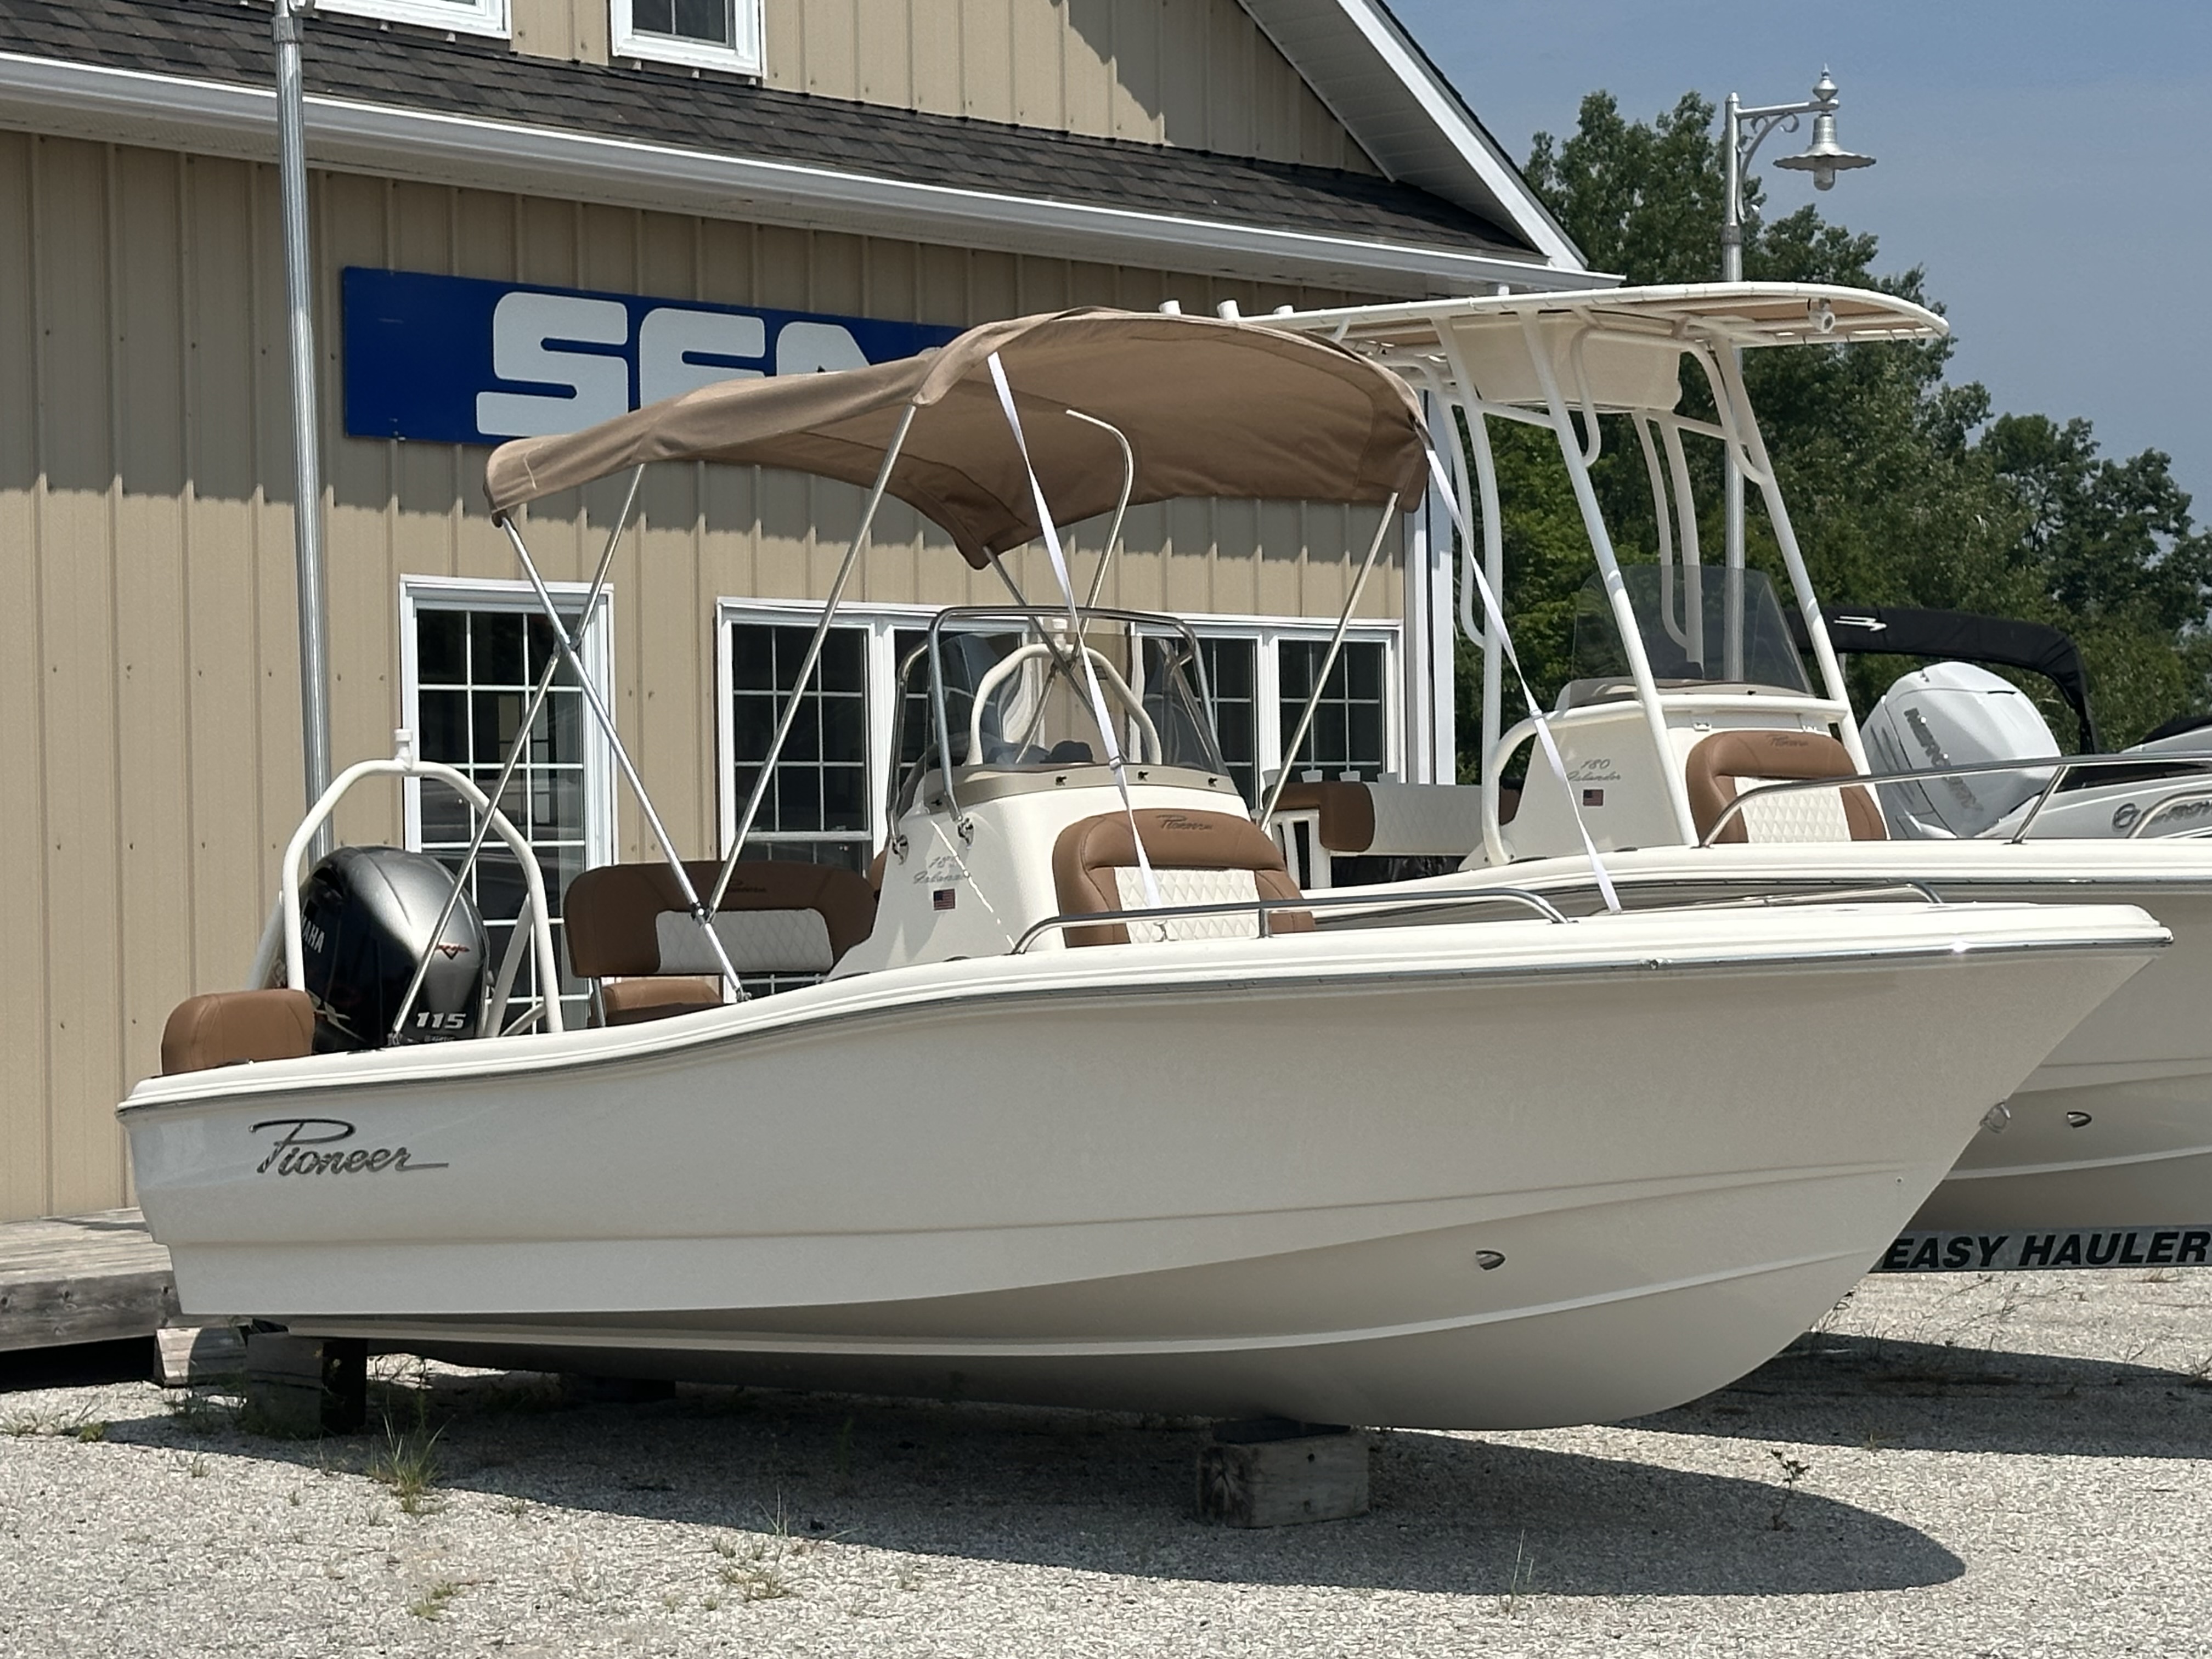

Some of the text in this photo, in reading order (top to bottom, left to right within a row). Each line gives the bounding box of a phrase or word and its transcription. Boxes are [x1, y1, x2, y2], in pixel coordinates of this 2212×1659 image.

[416, 1012, 466, 1030] 115
[249, 1118, 449, 1176] Pioneer
[1881, 1231, 2211, 1269] EASY HAULER
